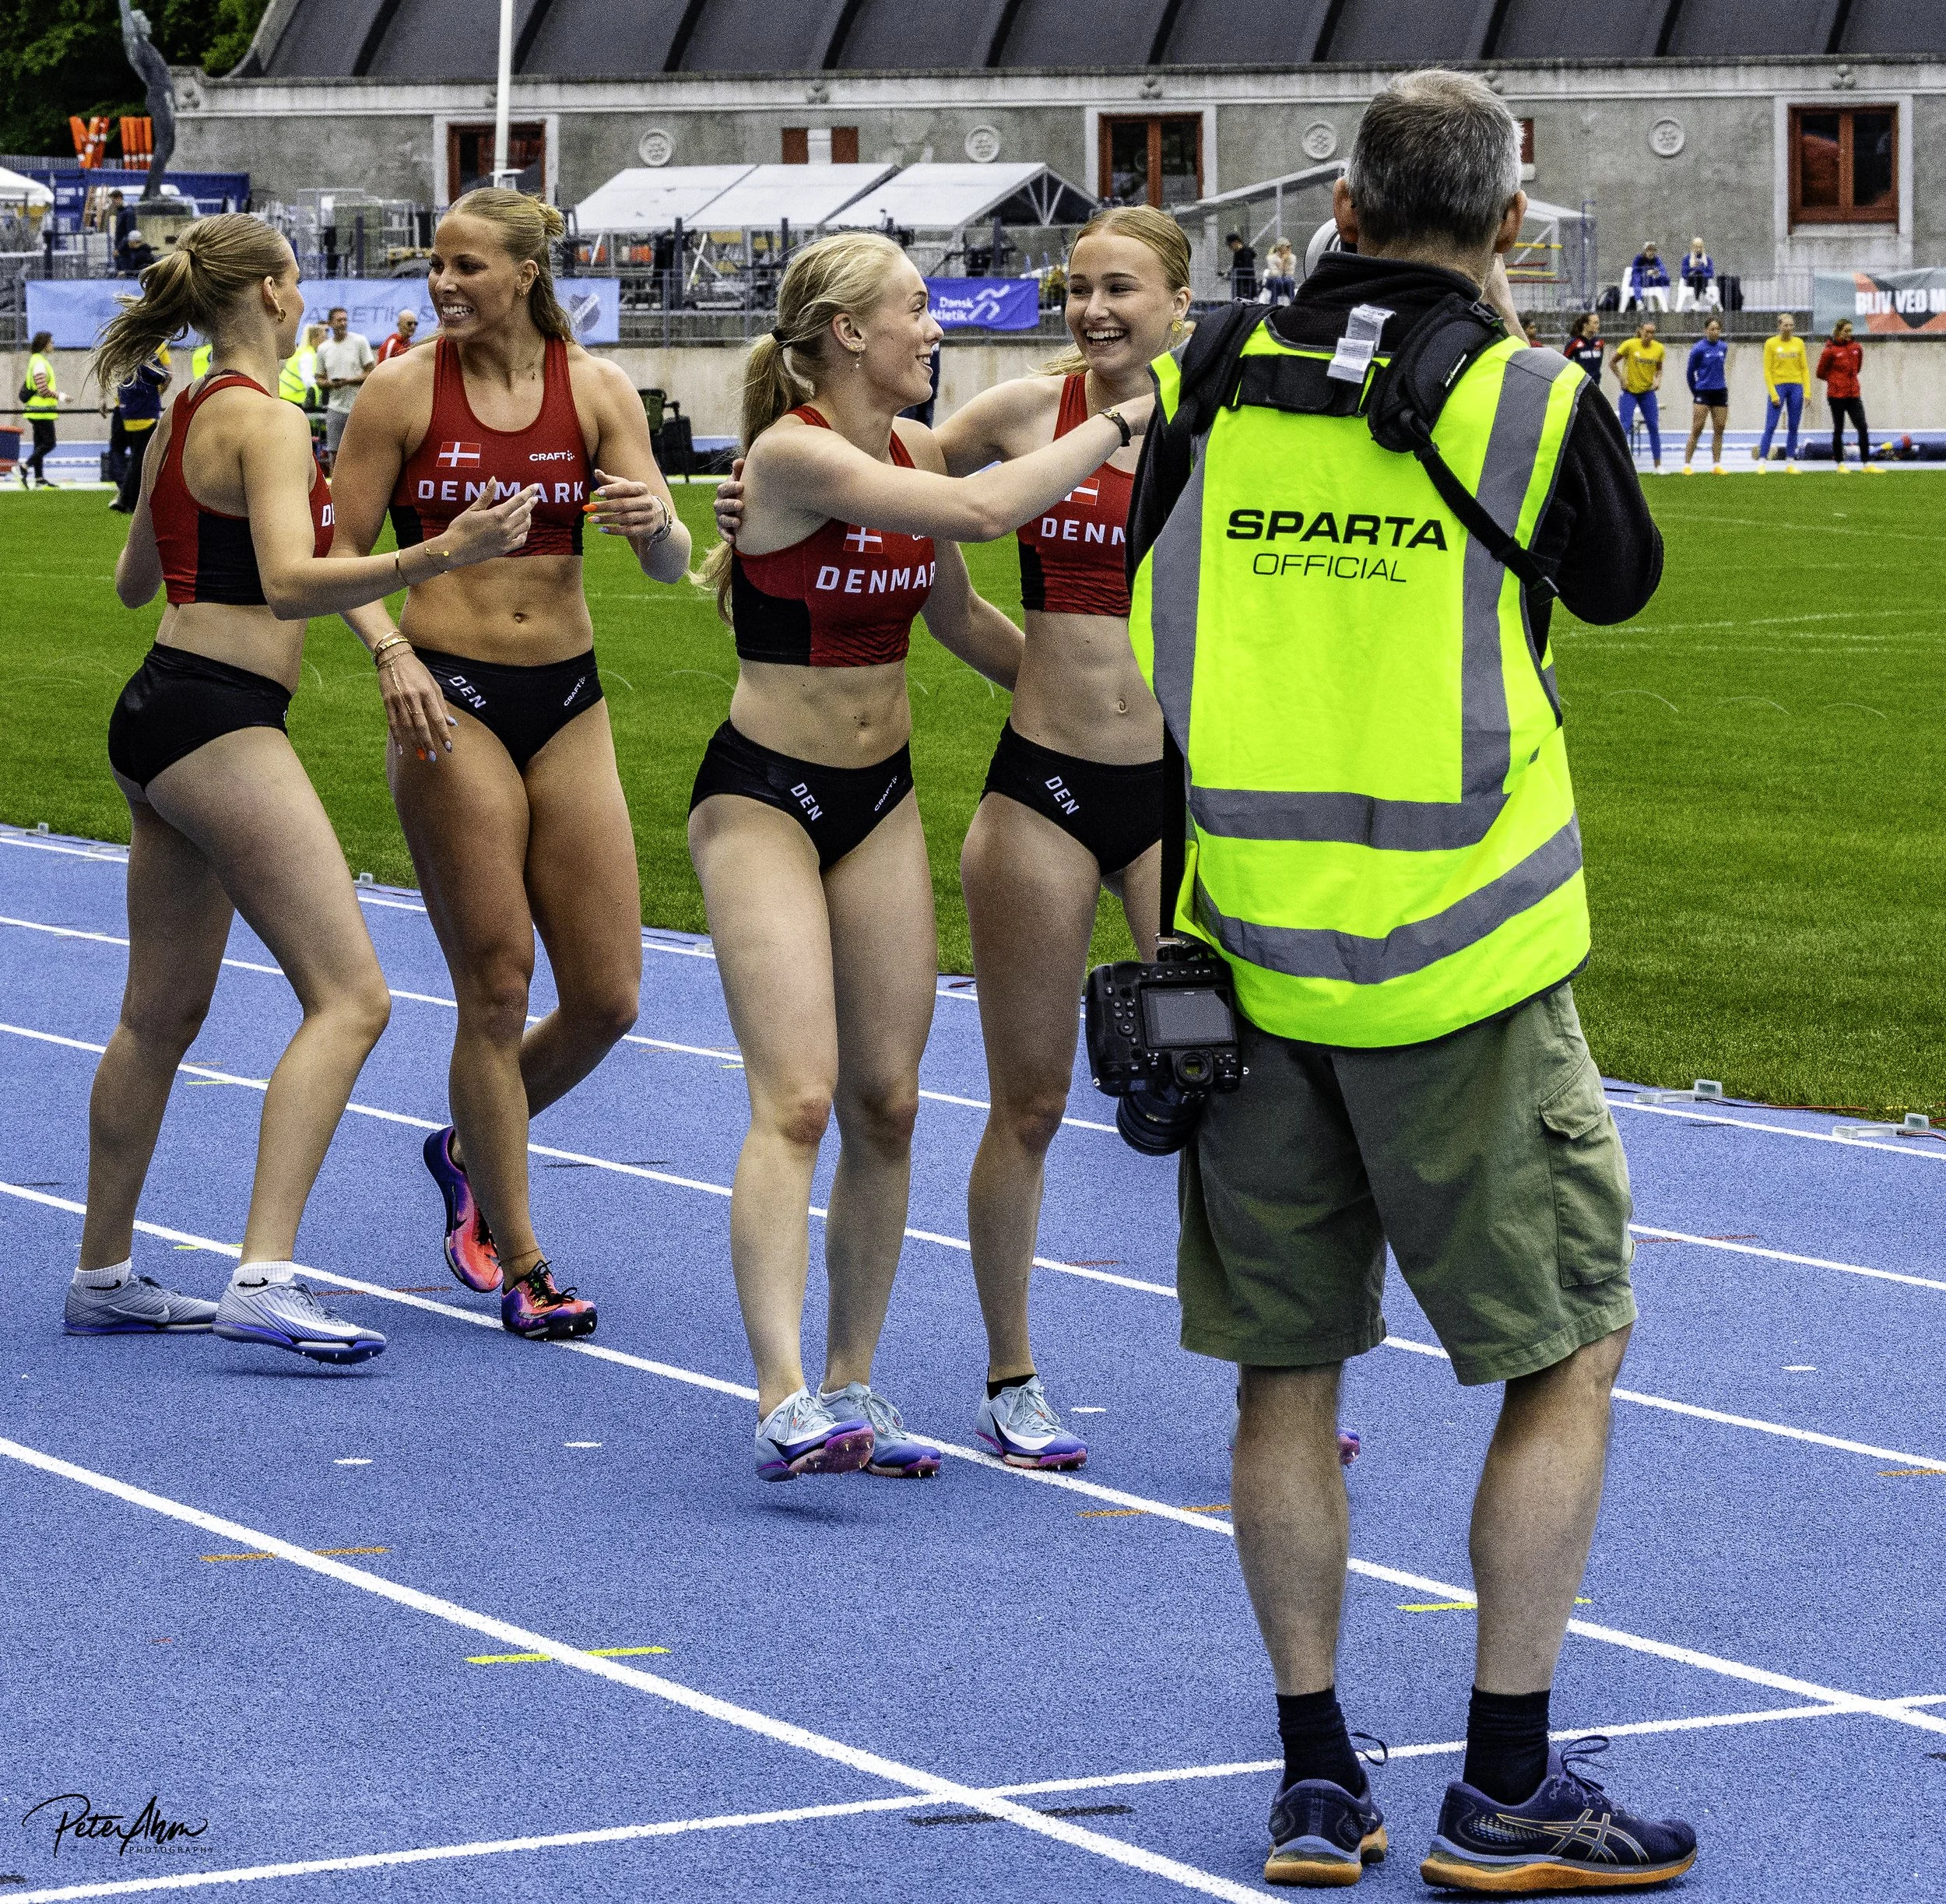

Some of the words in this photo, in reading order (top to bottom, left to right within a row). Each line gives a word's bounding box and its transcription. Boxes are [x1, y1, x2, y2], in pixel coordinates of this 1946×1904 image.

[940, 297, 974, 308] Dansk
[1856, 291, 1892, 315] BLIV
[1895, 289, 1927, 313] VED
[529, 452, 566, 461] CRAFT
[418, 480, 584, 503] DENMARK
[1227, 509, 1448, 551] SPARTA
[1253, 553, 1407, 582] OFFICIAL
[449, 675, 486, 708] DEN
[564, 682, 582, 706] CRAFT
[790, 782, 823, 821] DEN
[874, 782, 893, 811] CRAFT
[1045, 776, 1080, 815] DEN
